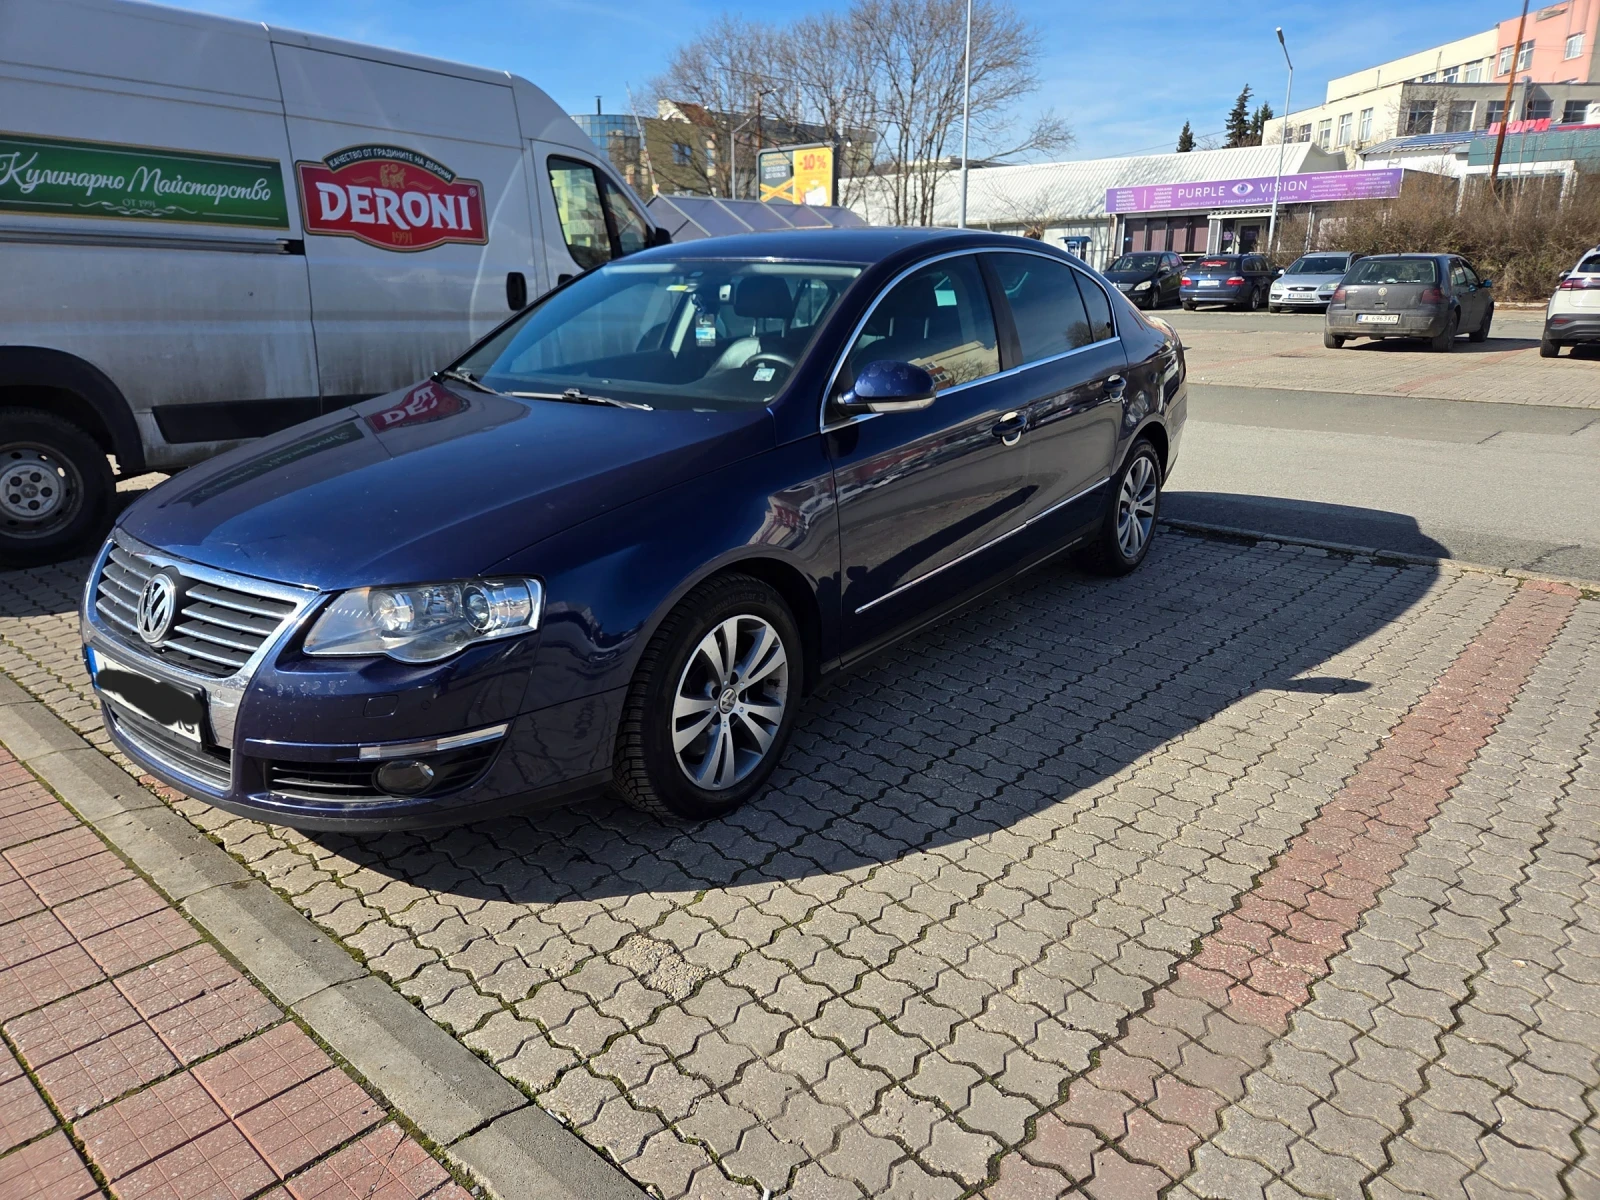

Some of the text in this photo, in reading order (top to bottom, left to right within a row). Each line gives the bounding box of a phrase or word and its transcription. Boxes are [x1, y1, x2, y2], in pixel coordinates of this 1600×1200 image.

[328, 148, 452, 181] КАЧЕСТВО ОТ ГРАДИНИТЕ НА ДЕРОНИ
[0, 151, 272, 205] Кулинарно Майсторство
[1177, 185, 1226, 199] PURPLE
[1259, 180, 1308, 193] VISION
[122, 198, 157, 209] ОТ 1991
[315, 181, 473, 231] DERONI
[391, 231, 413, 244] 1991
